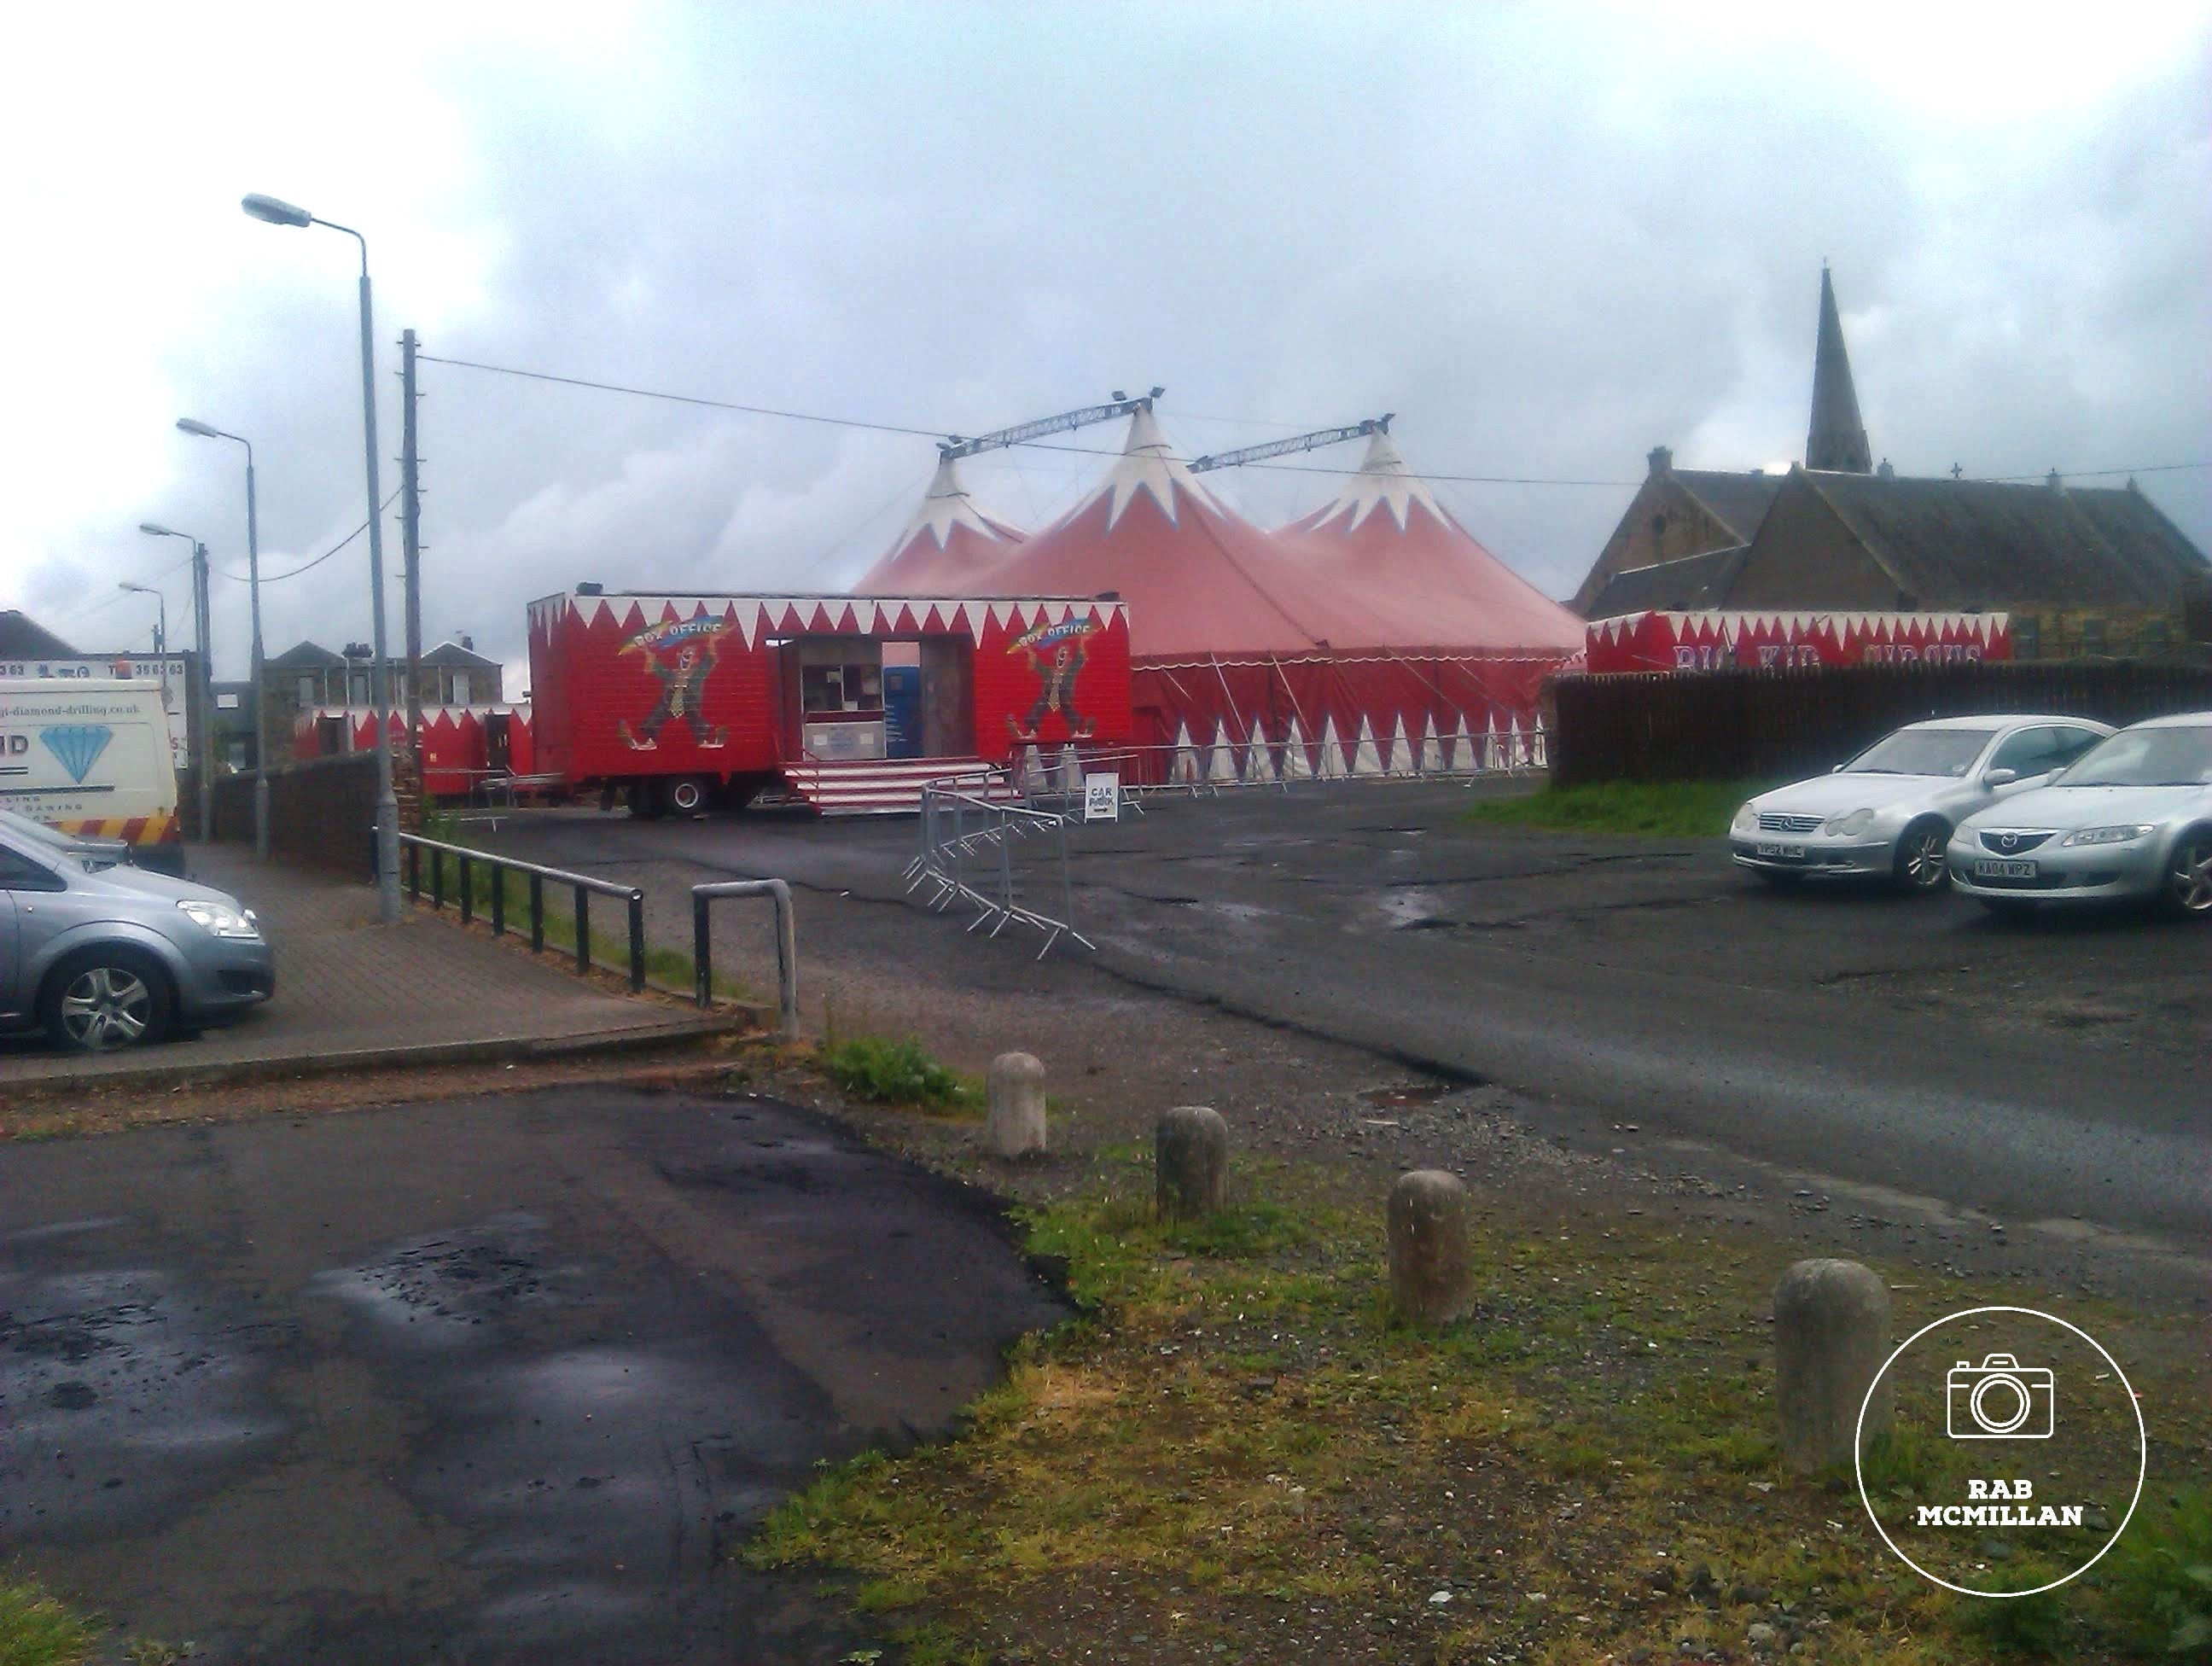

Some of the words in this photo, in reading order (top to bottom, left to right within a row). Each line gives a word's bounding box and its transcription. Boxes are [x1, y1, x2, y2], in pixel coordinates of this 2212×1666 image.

[634, 628, 663, 646] BOX
[669, 622, 722, 636] OFFICE
[1018, 632, 1042, 647] BOX
[1047, 625, 1090, 638] OFFICE
[1091, 787, 1112, 796] CAR
